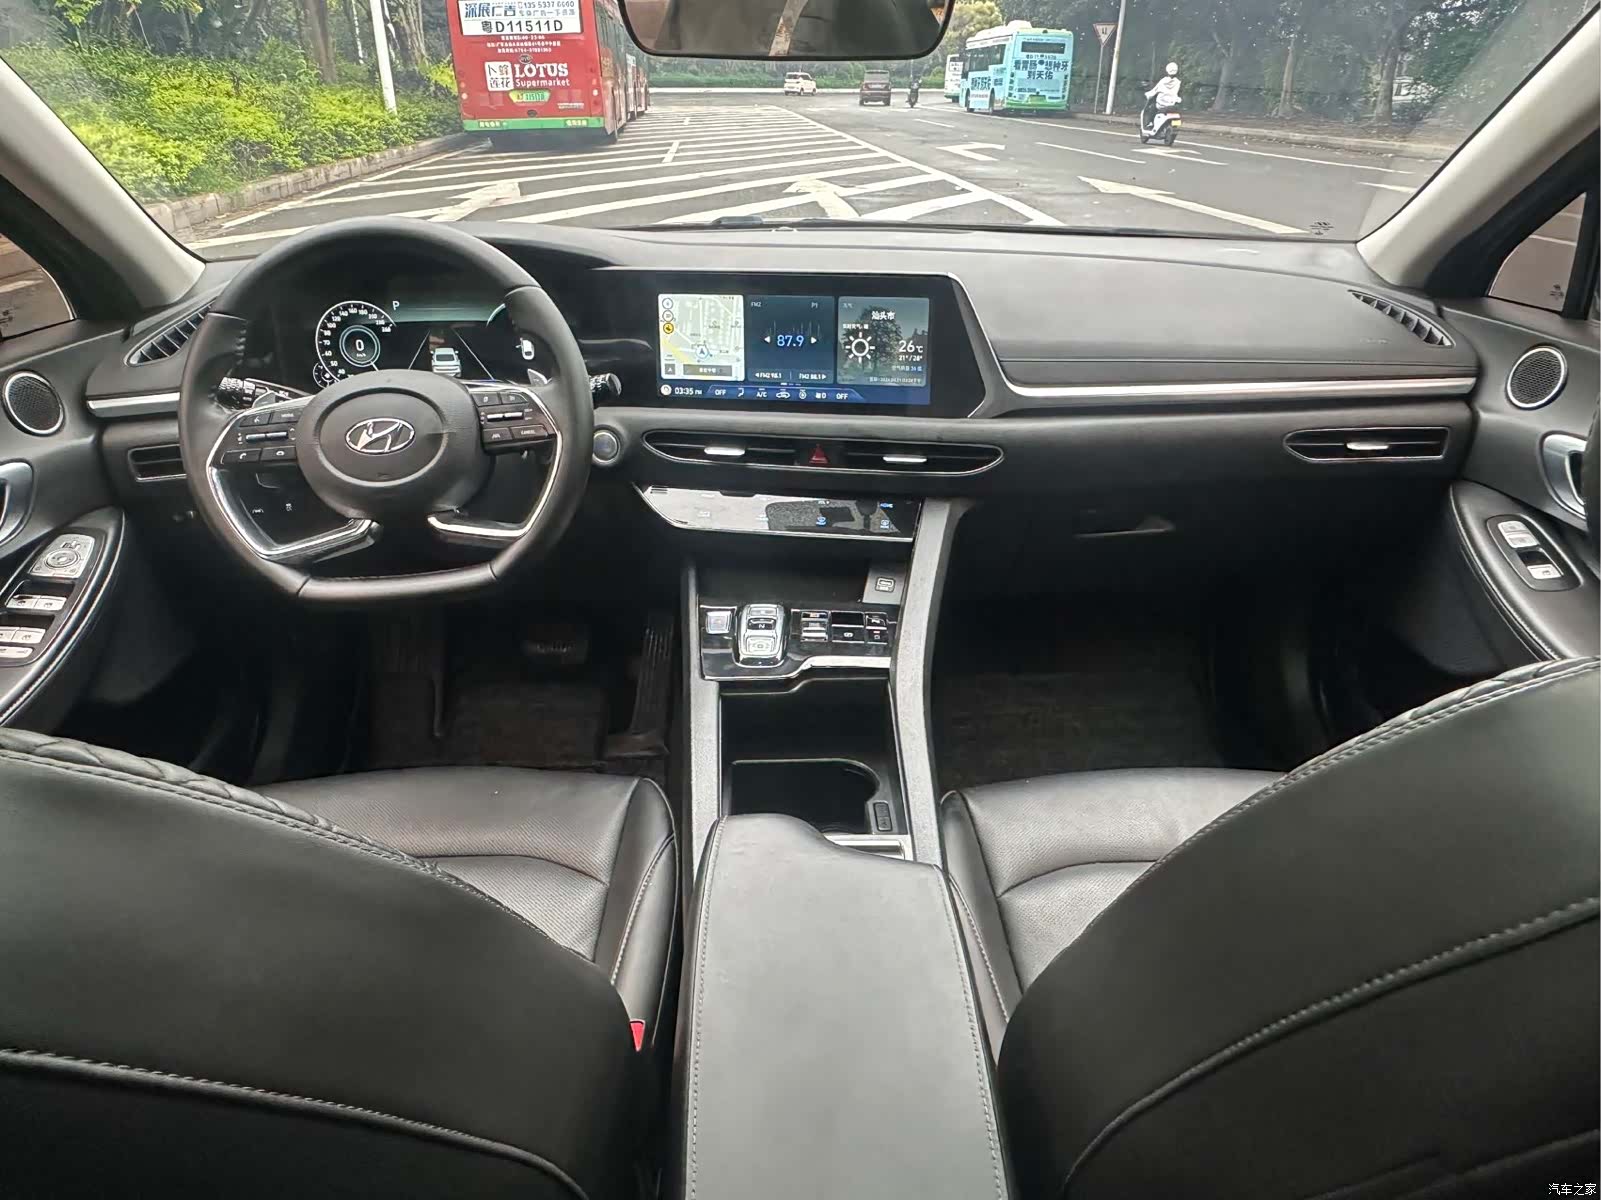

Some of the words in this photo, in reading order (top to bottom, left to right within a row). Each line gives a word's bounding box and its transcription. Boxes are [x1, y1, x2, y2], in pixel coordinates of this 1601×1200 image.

[481, 19, 563, 33] 粤D11511D
[514, 63, 569, 78] LOTUS
[516, 78, 571, 88] Supermarket
[392, 300, 400, 311] P
[355, 339, 365, 352] 0
[776, 334, 805, 347] 87.9
[674, 387, 694, 395] 03:35
